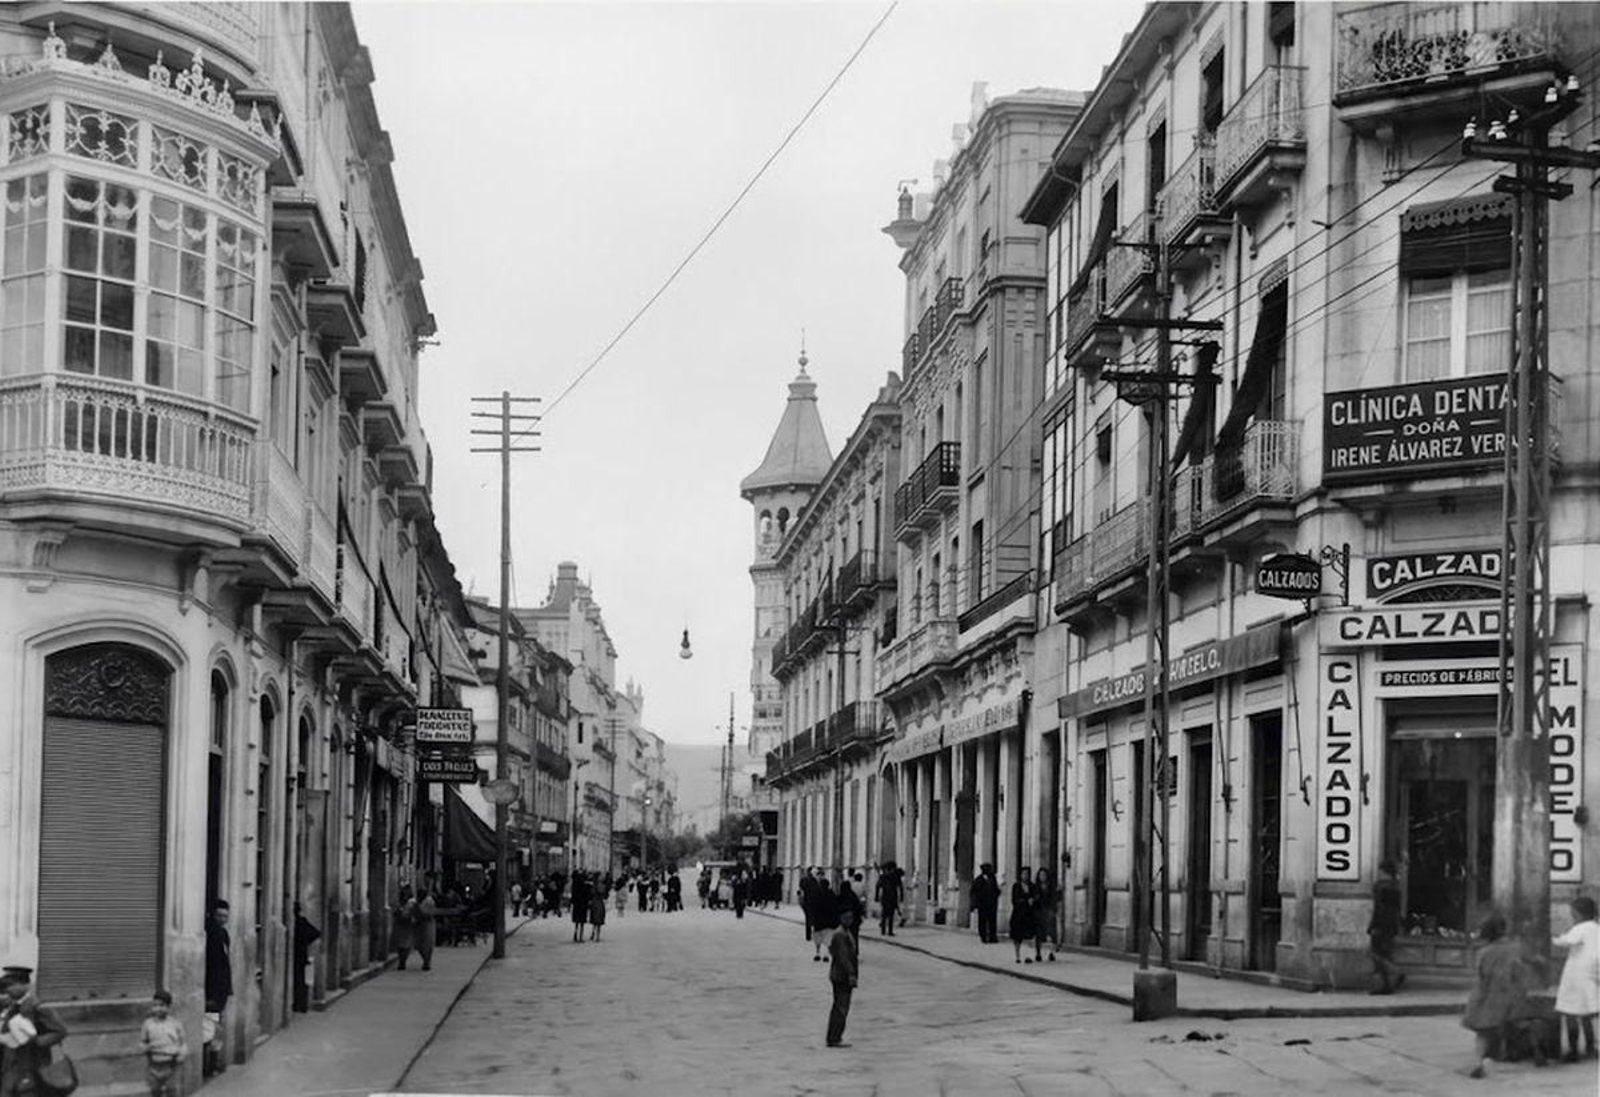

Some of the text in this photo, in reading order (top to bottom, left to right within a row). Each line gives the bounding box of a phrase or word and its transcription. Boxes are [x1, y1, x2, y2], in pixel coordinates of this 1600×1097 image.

[1331, 384, 1518, 426] CLÍNICA DENTA
[1403, 417, 1461, 437] DOÑA
[1331, 445, 1382, 468] IRENE
[1387, 439, 1463, 463] ÁLVAREZ
[1259, 569, 1319, 590] CALZADOS
[1371, 553, 1507, 590] CALZAD
[1339, 610, 1505, 641] CALZAD
[1384, 671, 1438, 685] PRECIOS
[1548, 657, 1578, 686] EL
[1093, 673, 1147, 705] CALZADO
[1326, 661, 1352, 872] CALZADOS
[1549, 705, 1577, 872] MODELO
